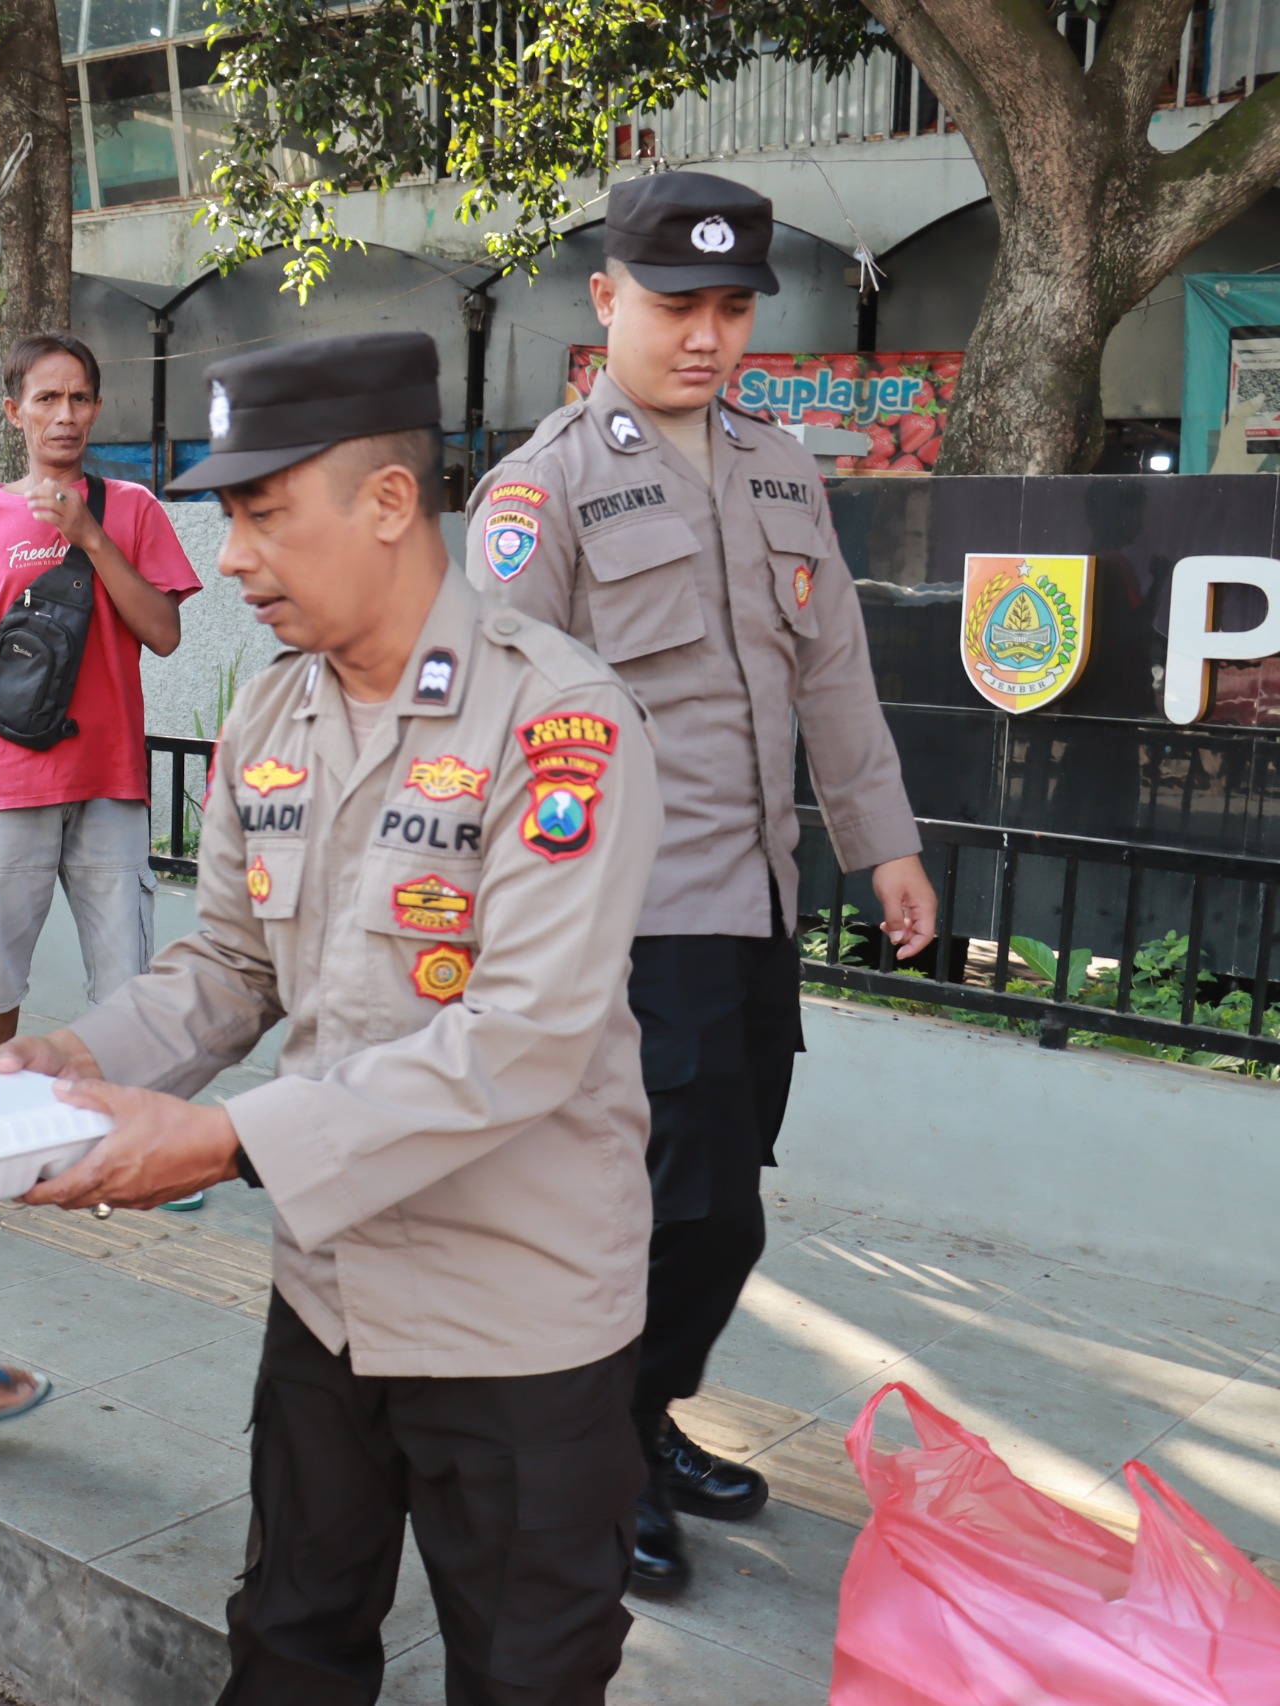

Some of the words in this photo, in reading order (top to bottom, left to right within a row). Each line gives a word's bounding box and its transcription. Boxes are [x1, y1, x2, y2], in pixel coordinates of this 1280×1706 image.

[737, 368, 923, 426] Suplayer
[492, 485, 543, 503] BAHARKAM
[749, 479, 808, 504] POLRI
[578, 484, 666, 527] KURNIAWAN
[489, 513, 535, 530] BINMAS
[6, 539, 70, 568] Freedo
[15, 561, 42, 569] FASHION
[989, 679, 1046, 693] JEMBER
[532, 716, 605, 735] POLRES
[380, 810, 482, 851] POLR
